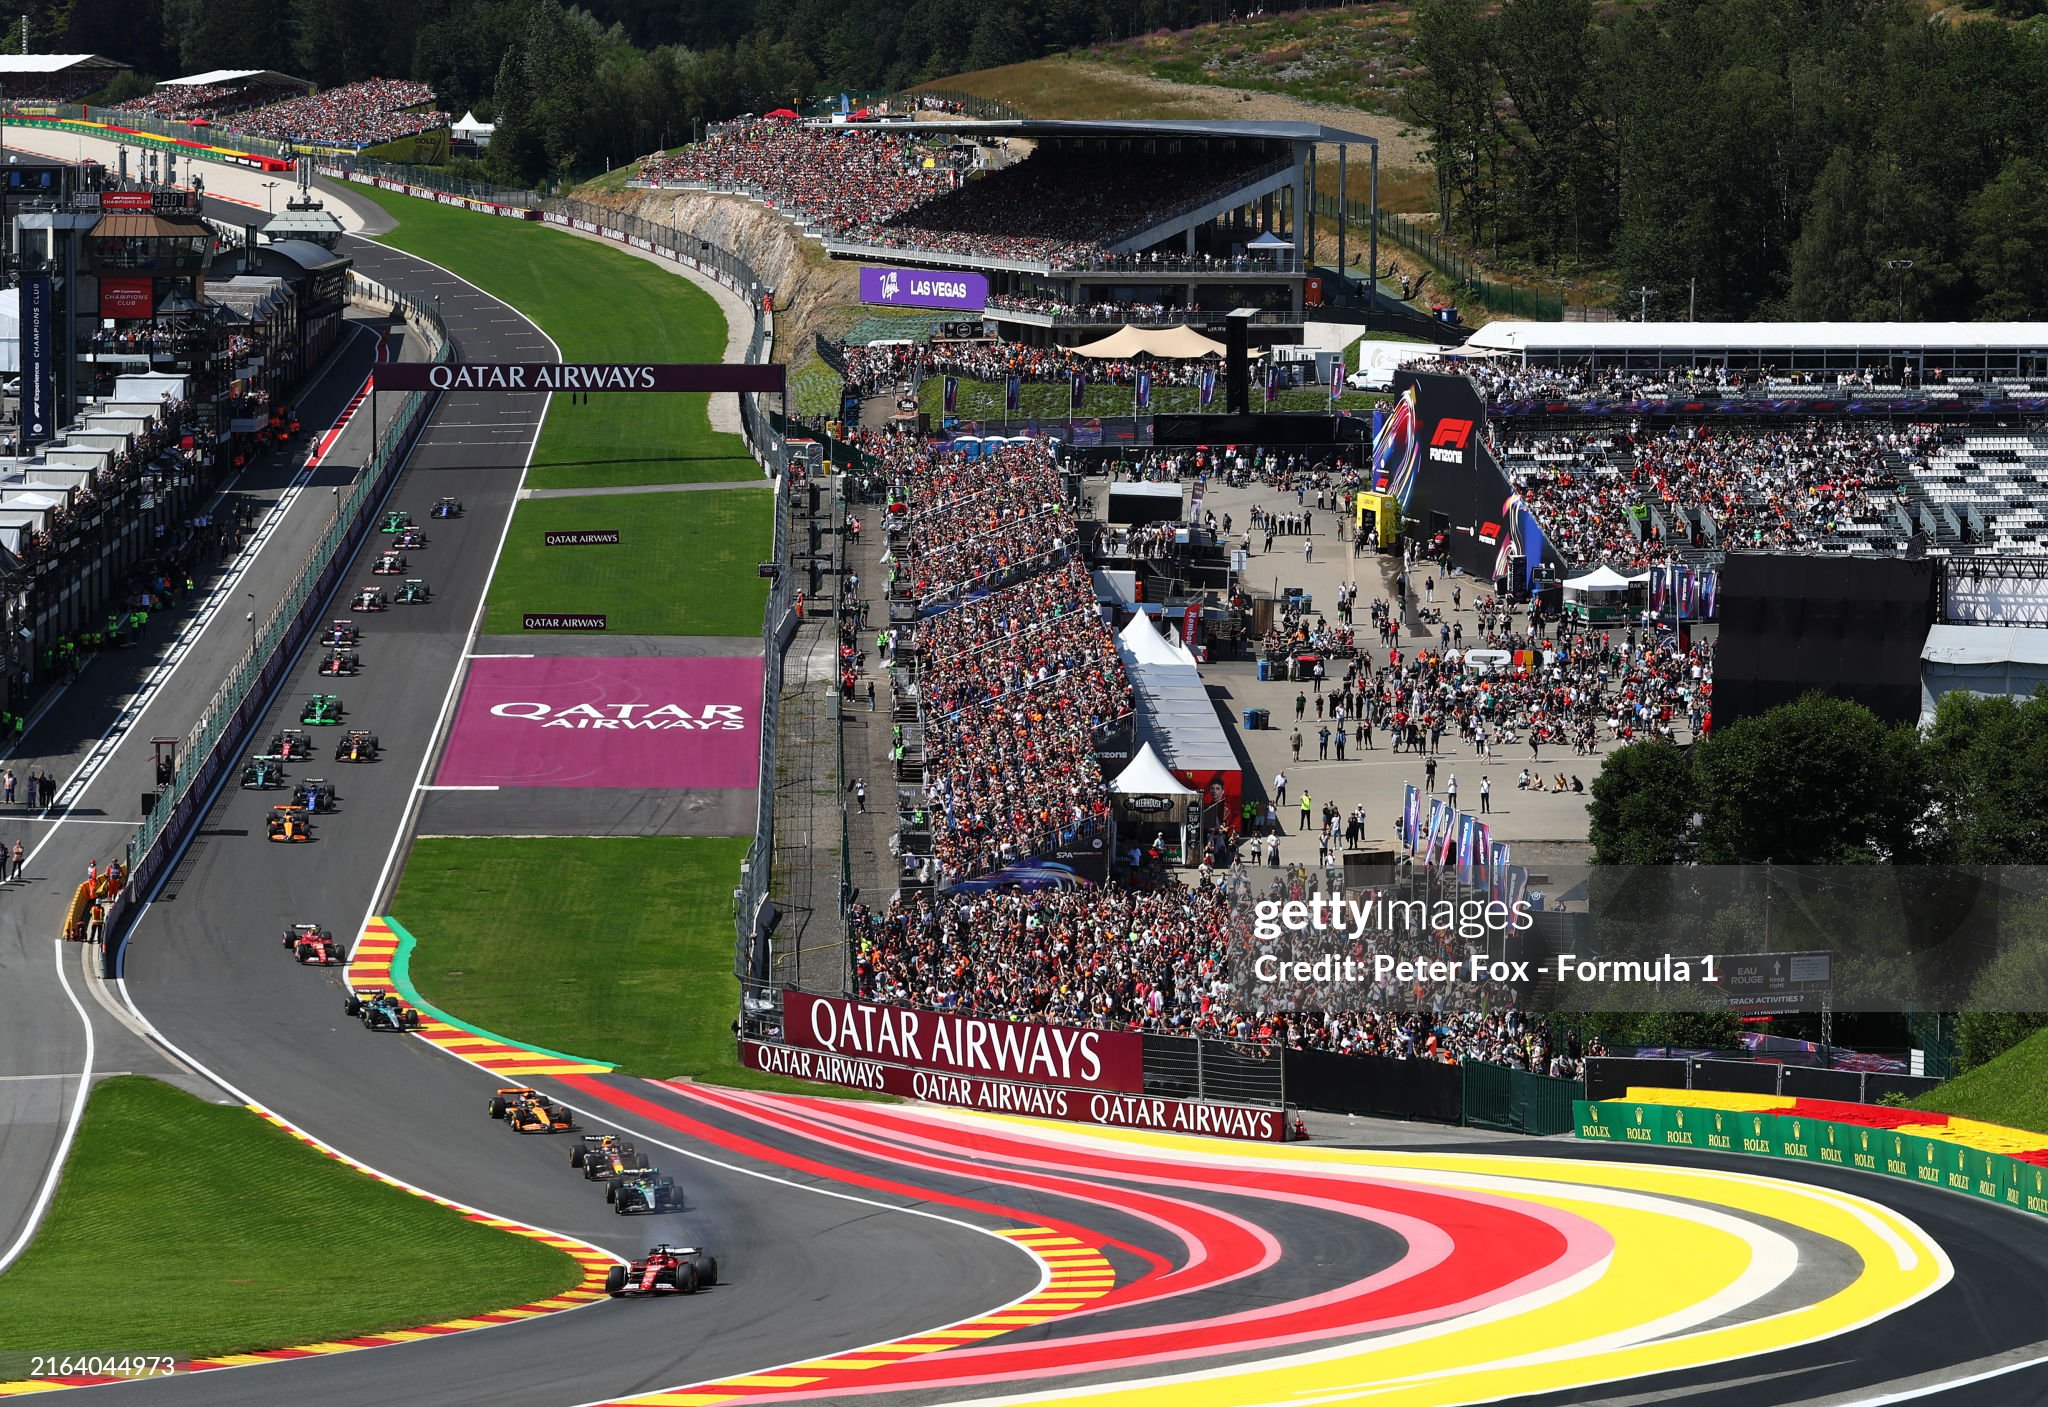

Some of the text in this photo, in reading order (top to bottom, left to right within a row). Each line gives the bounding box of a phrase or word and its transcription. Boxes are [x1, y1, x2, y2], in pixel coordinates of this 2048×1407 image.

[910, 280, 967, 298] LAS VEGAS
[429, 366, 656, 389] QATAR AIRWAYS
[546, 534, 618, 545] QATAR AIRWAYS
[525, 618, 604, 629] QATAR AIRWAYS
[490, 702, 745, 720] QATAR
[541, 718, 745, 730] AIRWAYS
[1135, 798, 1162, 808] BEERHOUSE
[1737, 967, 1757, 975] EAU
[1731, 976, 1764, 984] ROUGE
[1730, 997, 1754, 1005] TRACK
[1755, 995, 1798, 1004] ACTIVITIES
[811, 999, 1101, 1081] QATAR AIRWAYS
[758, 1045, 885, 1090] QATAR AIRWAYS
[913, 1072, 1068, 1116] QATAR AIRWAYS
[1090, 1094, 1273, 1138] QATAR AIRWAYS
[1582, 1125, 1611, 1138] ROLEX
[1626, 1128, 1652, 1140] ROLEX
[1667, 1131, 1693, 1144] ROLEX
[1708, 1134, 1731, 1148] ROLEX
[1744, 1138, 1770, 1153] ROLEX
[1784, 1142, 1808, 1157] ROLEX
[1820, 1147, 1842, 1162] ROLEX
[1854, 1153, 1875, 1169] ROLEX
[1887, 1159, 1907, 1175] ROLEX
[1918, 1165, 1940, 1182] ROLEX
[1949, 1172, 1969, 1190] ROLEX
[1979, 1180, 1996, 1197] ROLEX
